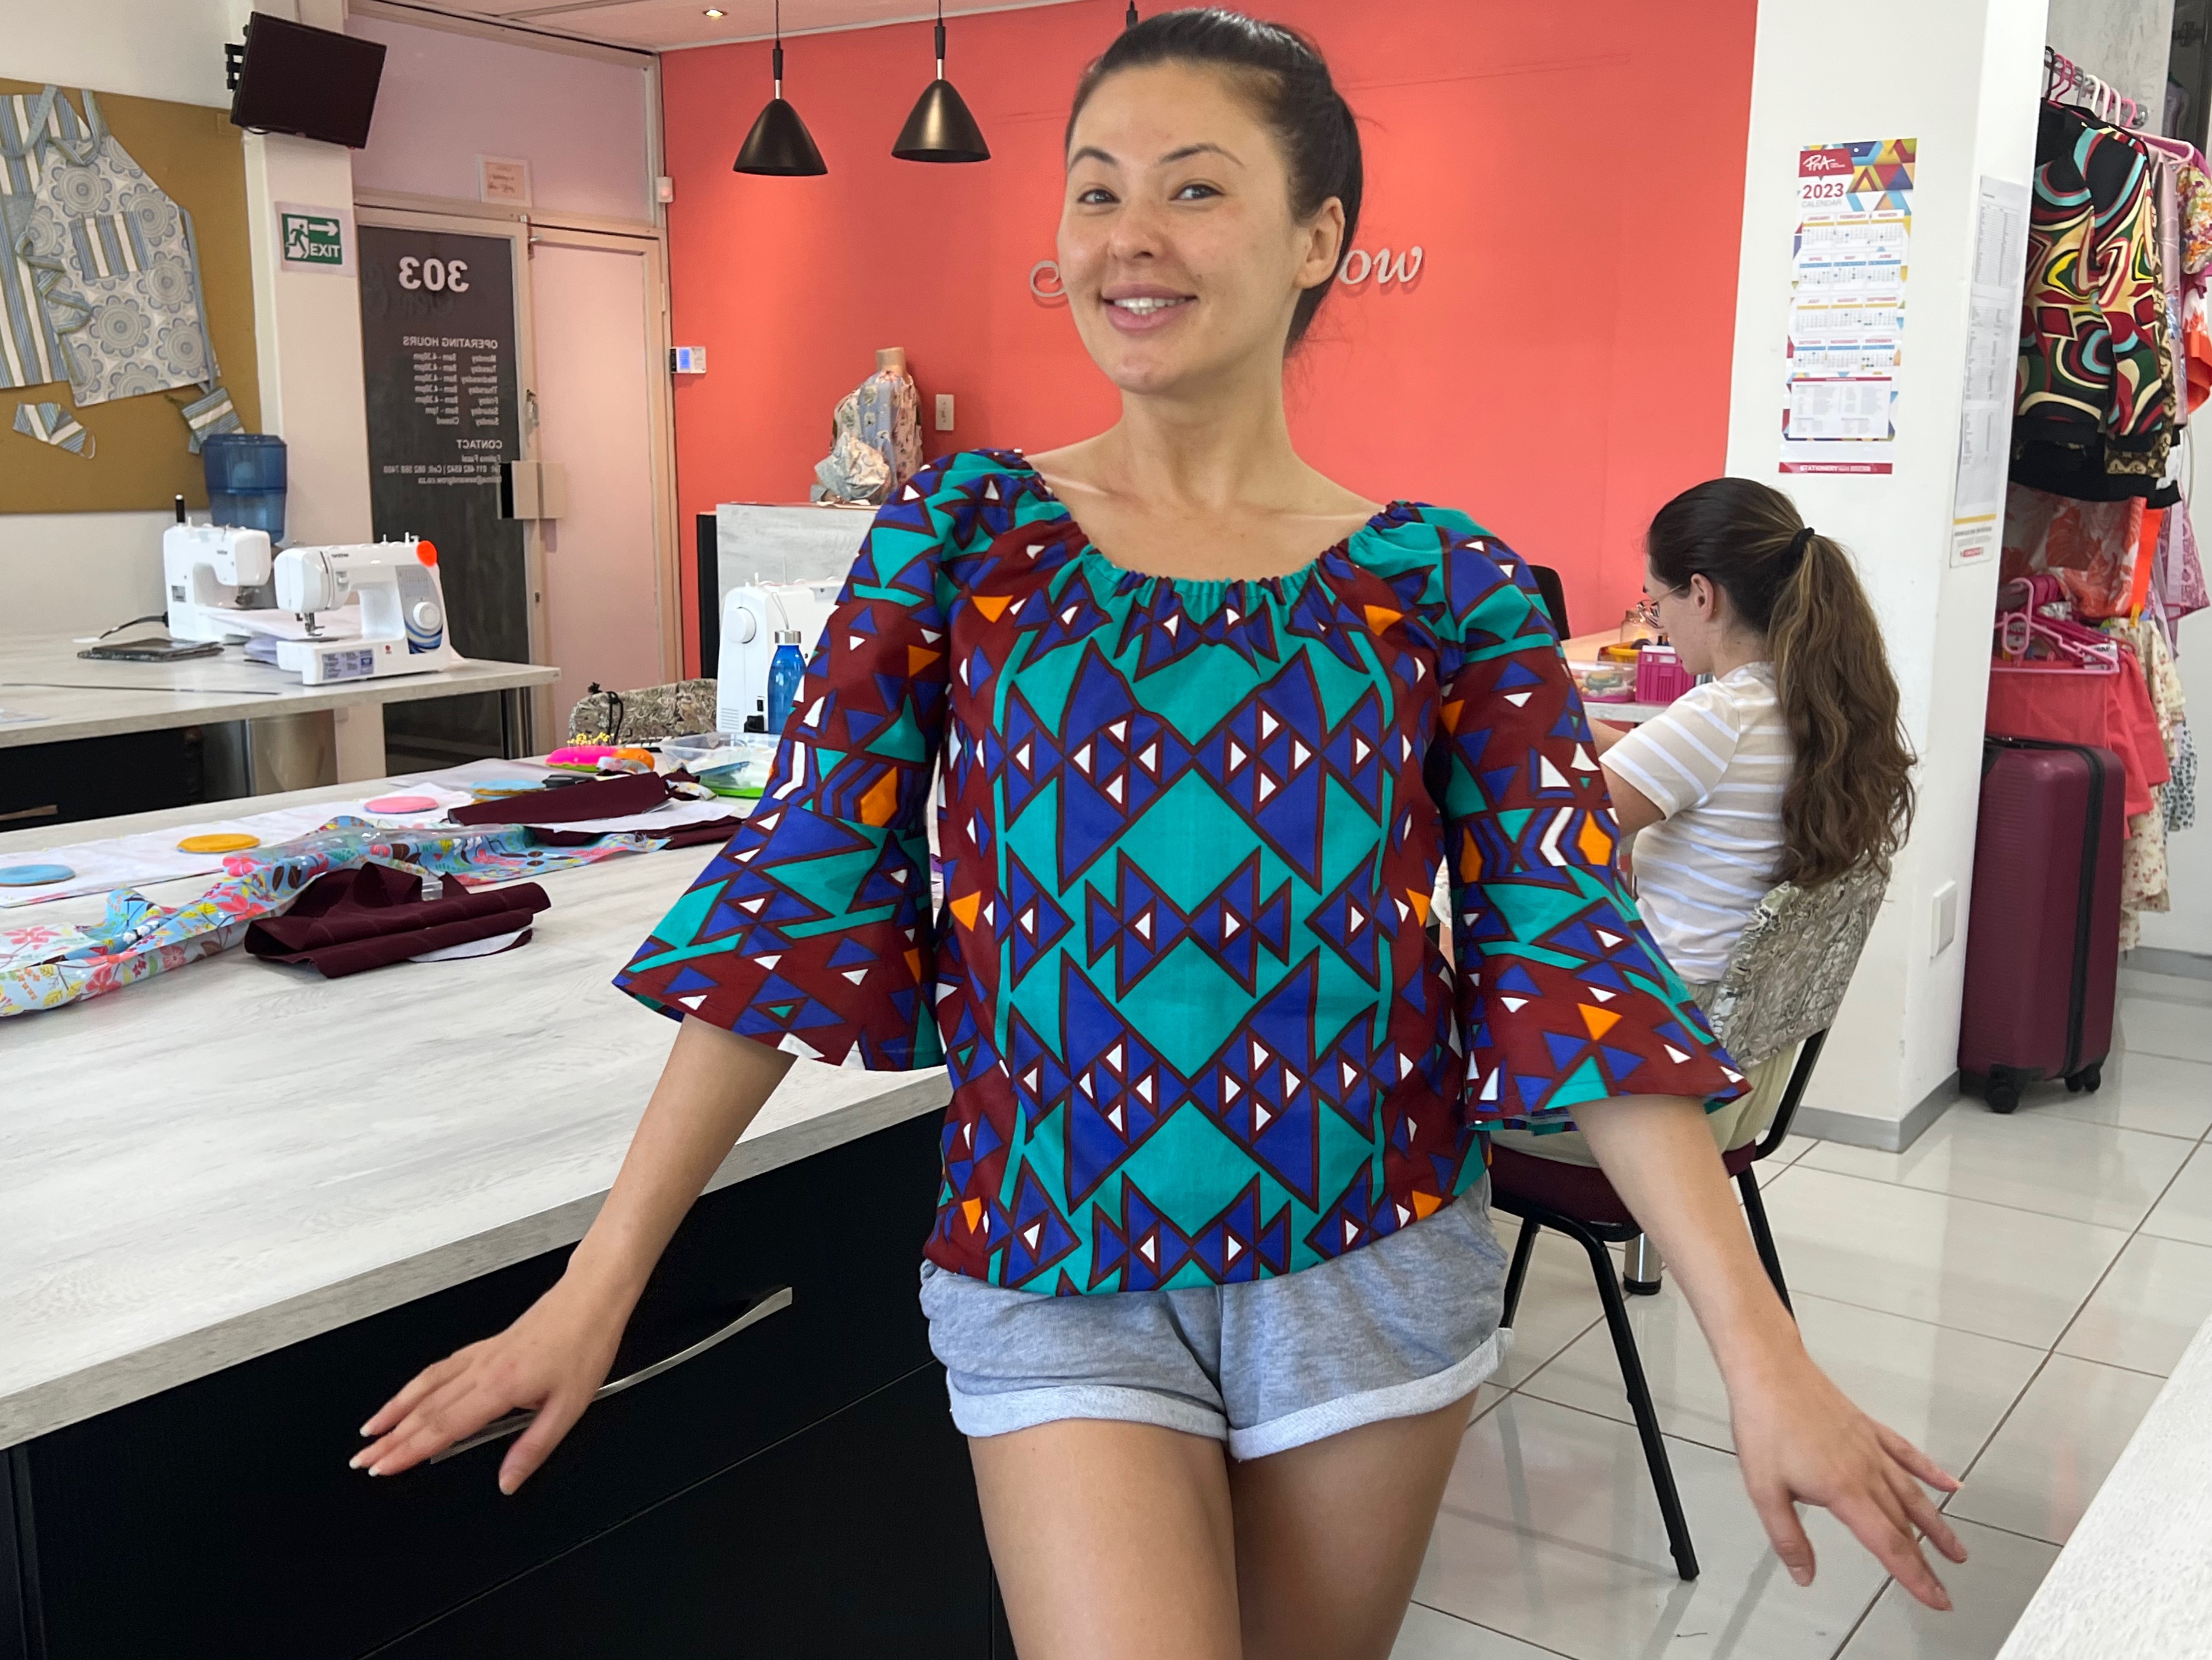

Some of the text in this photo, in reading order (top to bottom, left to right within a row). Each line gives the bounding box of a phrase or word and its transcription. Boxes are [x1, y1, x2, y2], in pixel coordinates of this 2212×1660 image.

[1803, 183, 1844, 199] 2023
[1802, 199, 1841, 208] CALENDAR
[310, 243, 340, 258] EXIT
